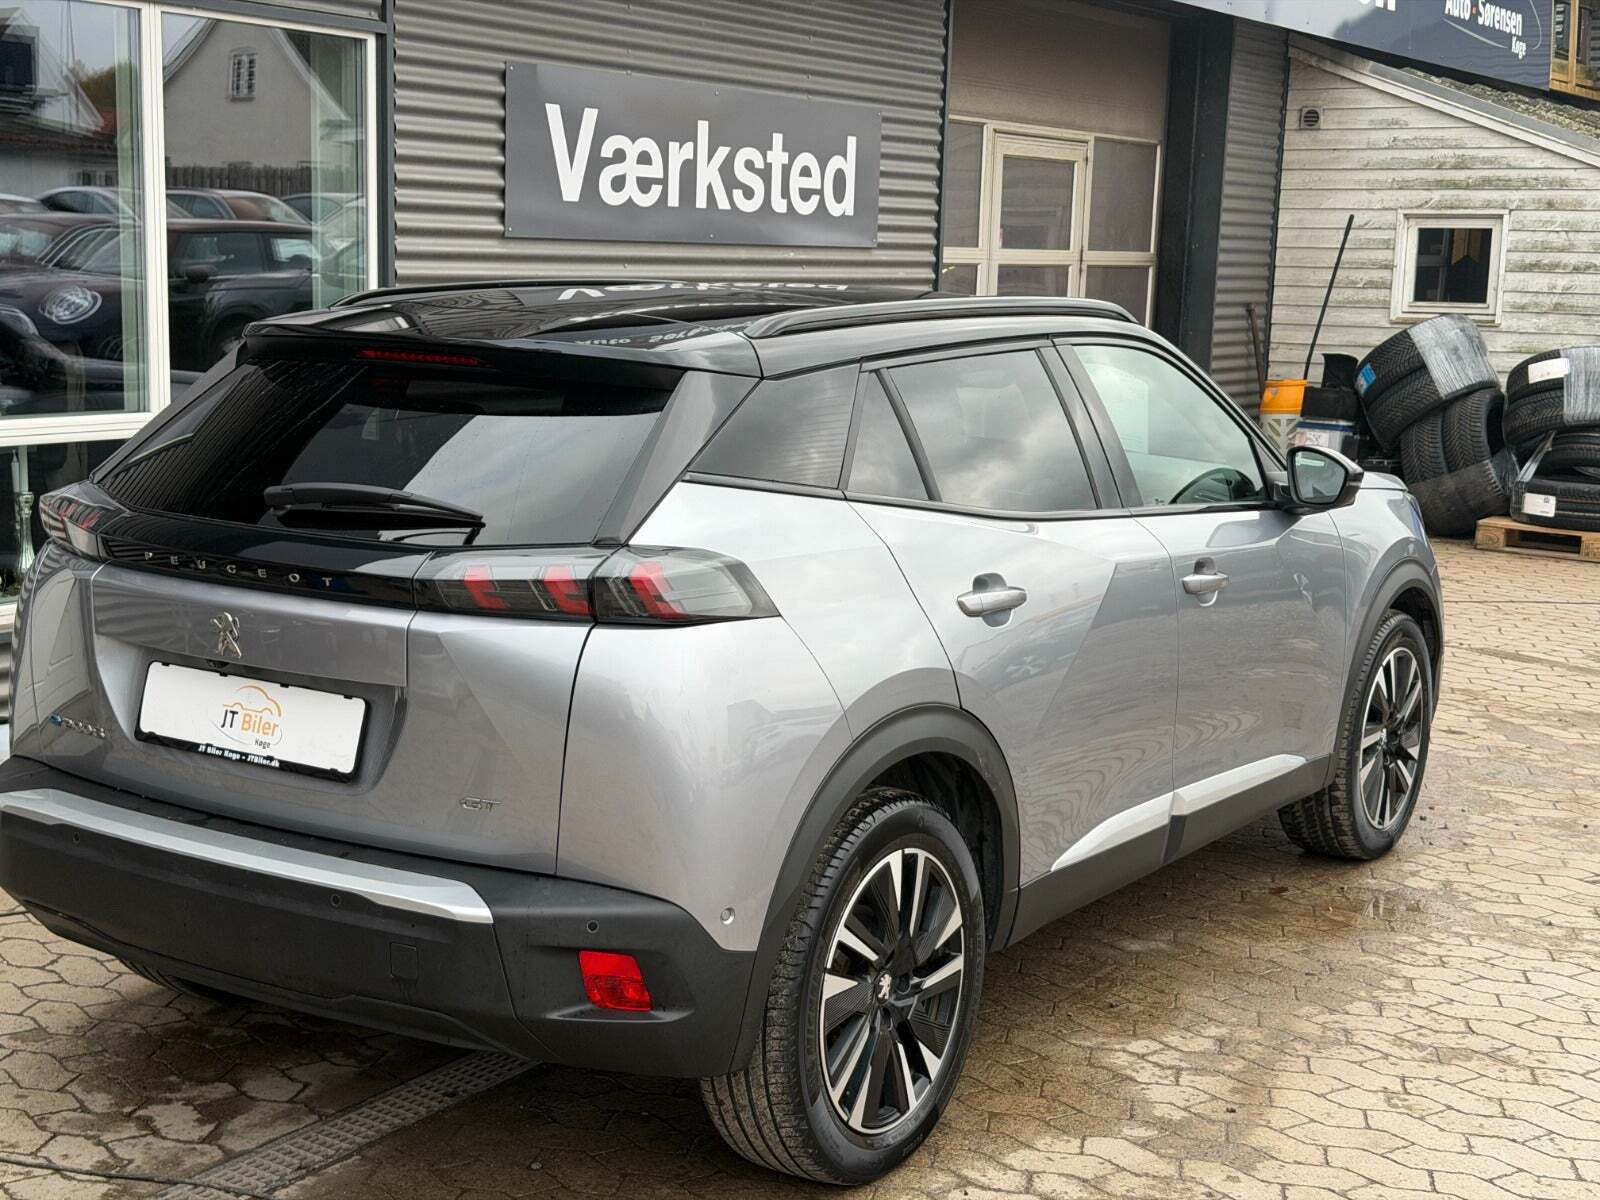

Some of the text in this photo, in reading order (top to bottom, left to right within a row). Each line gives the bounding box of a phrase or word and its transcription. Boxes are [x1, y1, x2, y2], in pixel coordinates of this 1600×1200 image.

[1444, 0, 1523, 36] Auto Sørensen
[545, 102, 857, 217] Værksted
[144, 551, 333, 587] PEUGEOT
[221, 708, 279, 737] JT Biler
[197, 743, 206, 752] JT
[460, 797, 502, 812] GT
